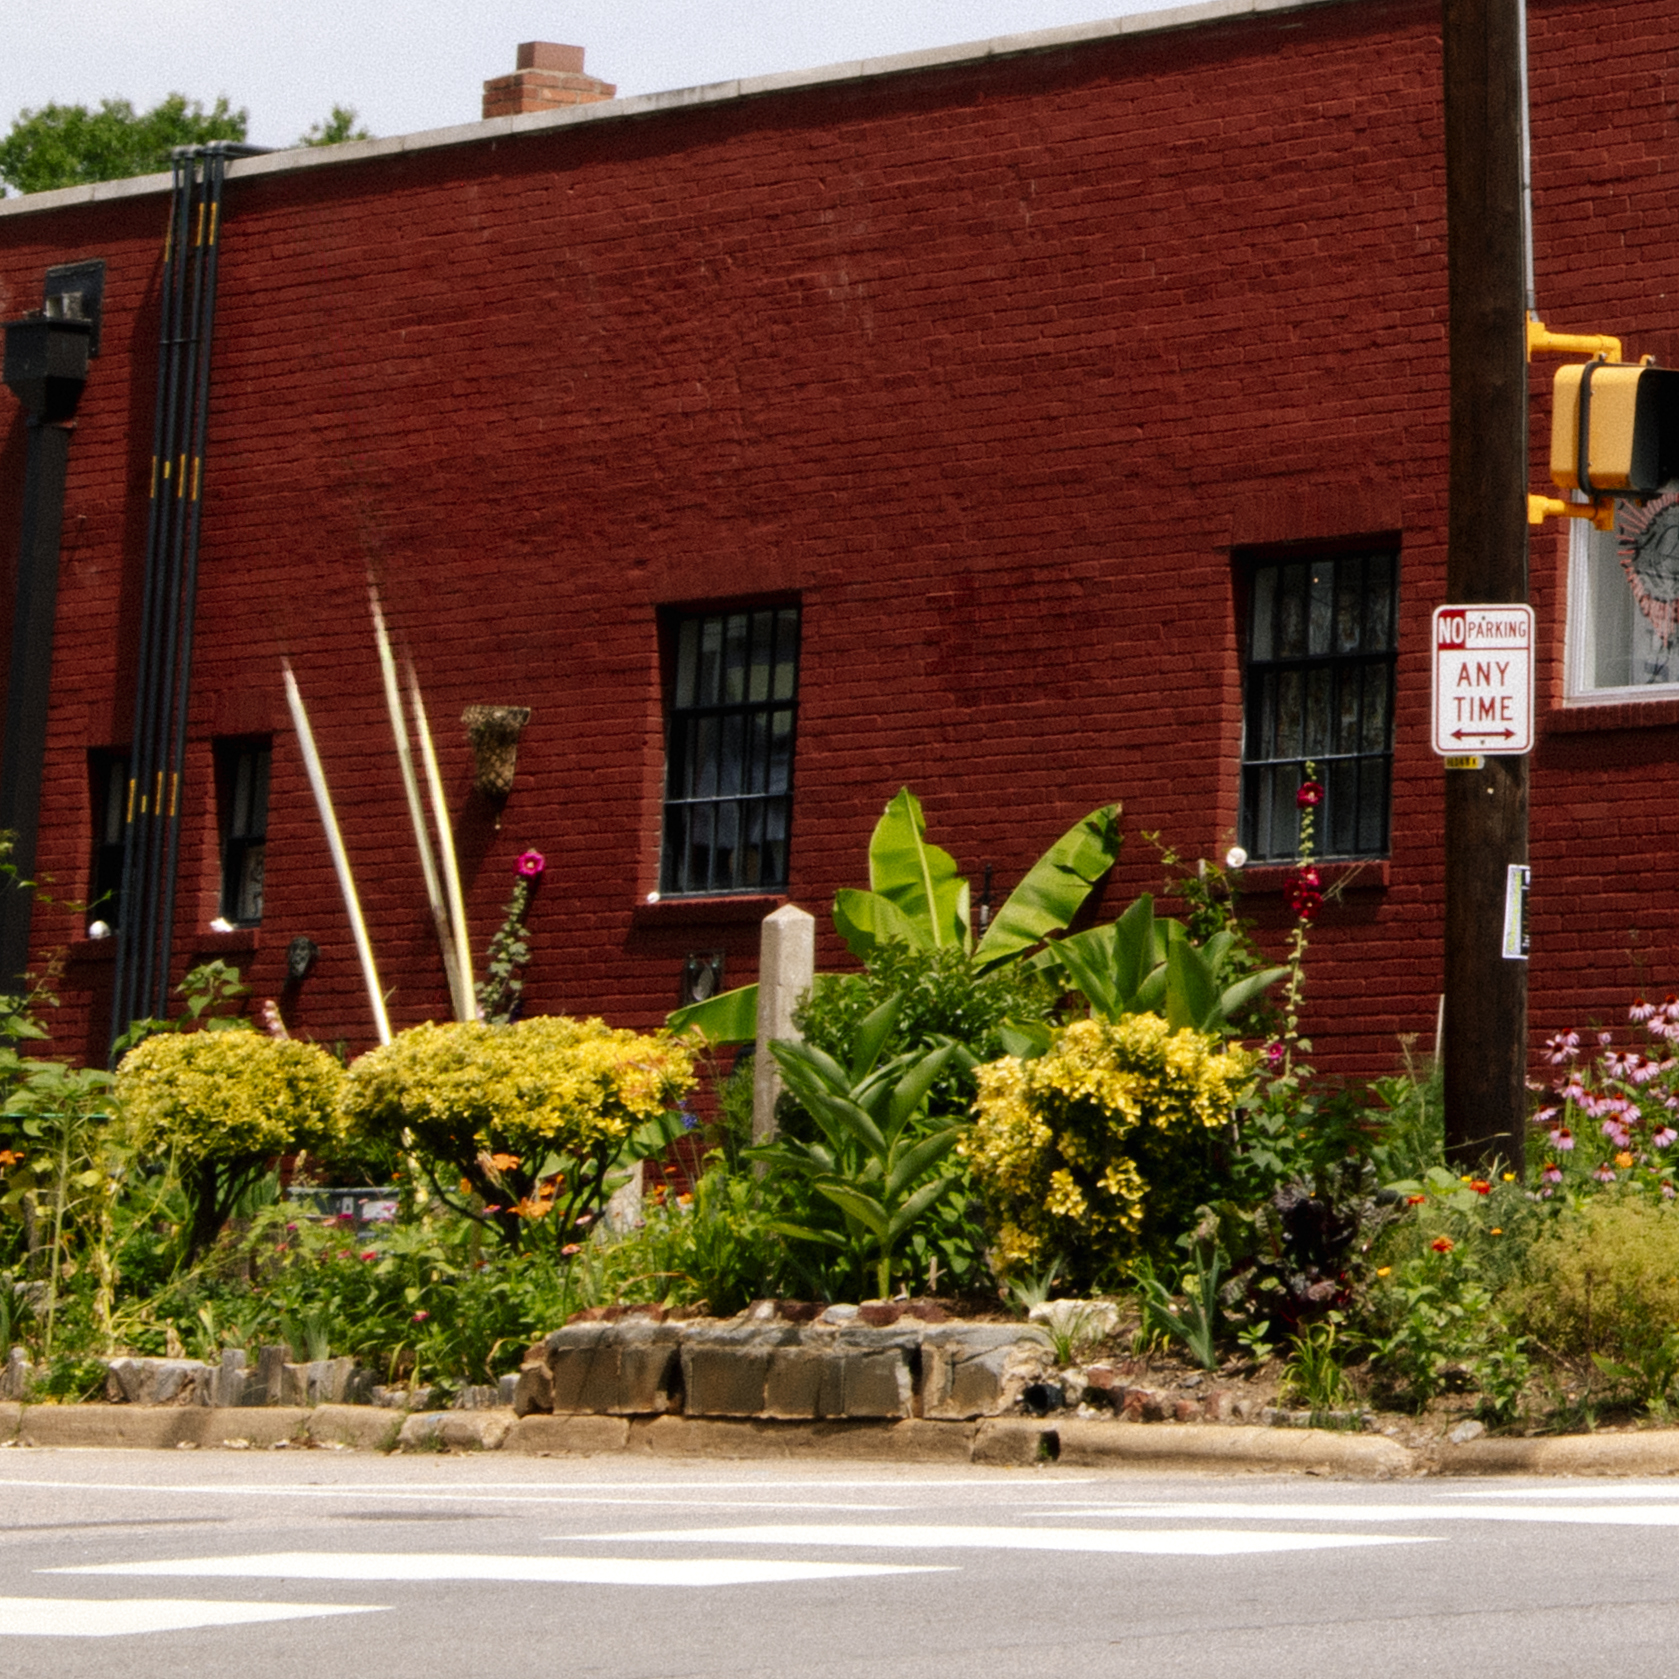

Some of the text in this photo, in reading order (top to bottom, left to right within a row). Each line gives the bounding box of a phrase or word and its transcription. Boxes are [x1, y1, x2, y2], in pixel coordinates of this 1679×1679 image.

[1438, 617, 1527, 644] NO PARKING
[1456, 661, 1510, 687] ANY
[1453, 696, 1513, 722] TIME
